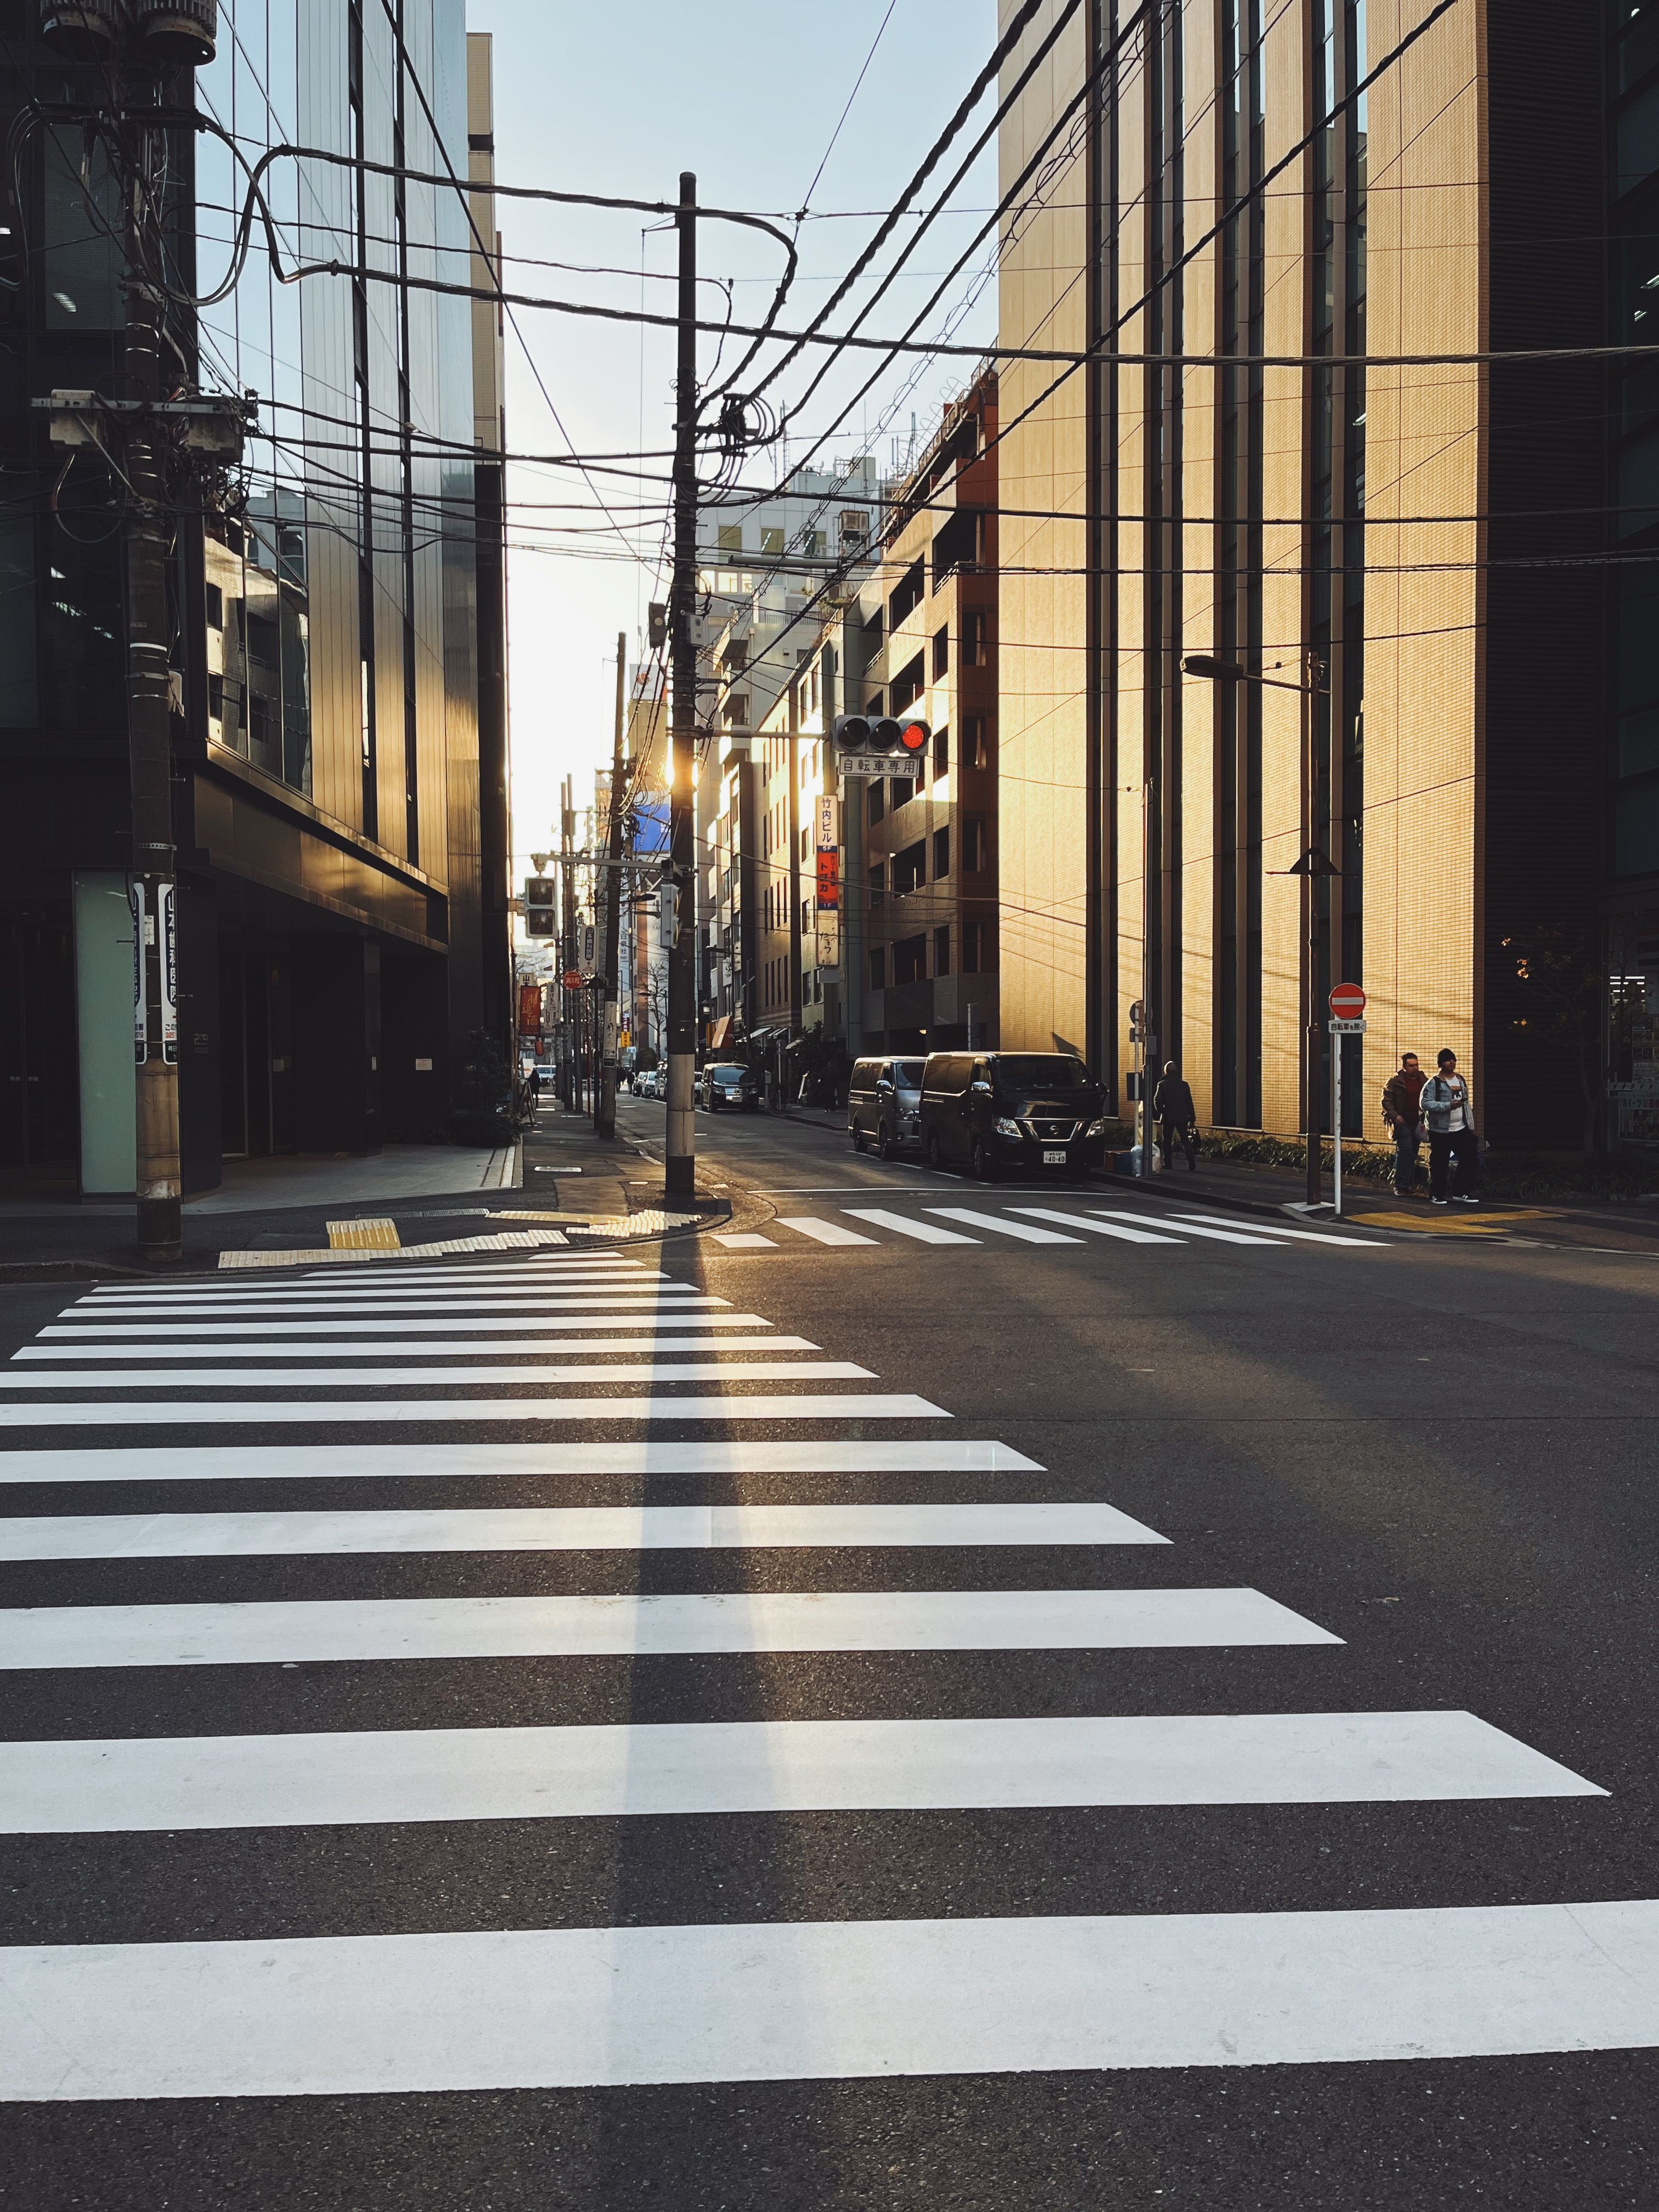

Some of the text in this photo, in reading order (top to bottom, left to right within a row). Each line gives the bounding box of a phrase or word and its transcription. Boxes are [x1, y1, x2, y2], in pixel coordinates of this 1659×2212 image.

[844, 758, 915, 774] 自転車専用
[821, 797, 831, 843] 竹内ビル
[1331, 1023, 1365, 1031] 自転車を除く
